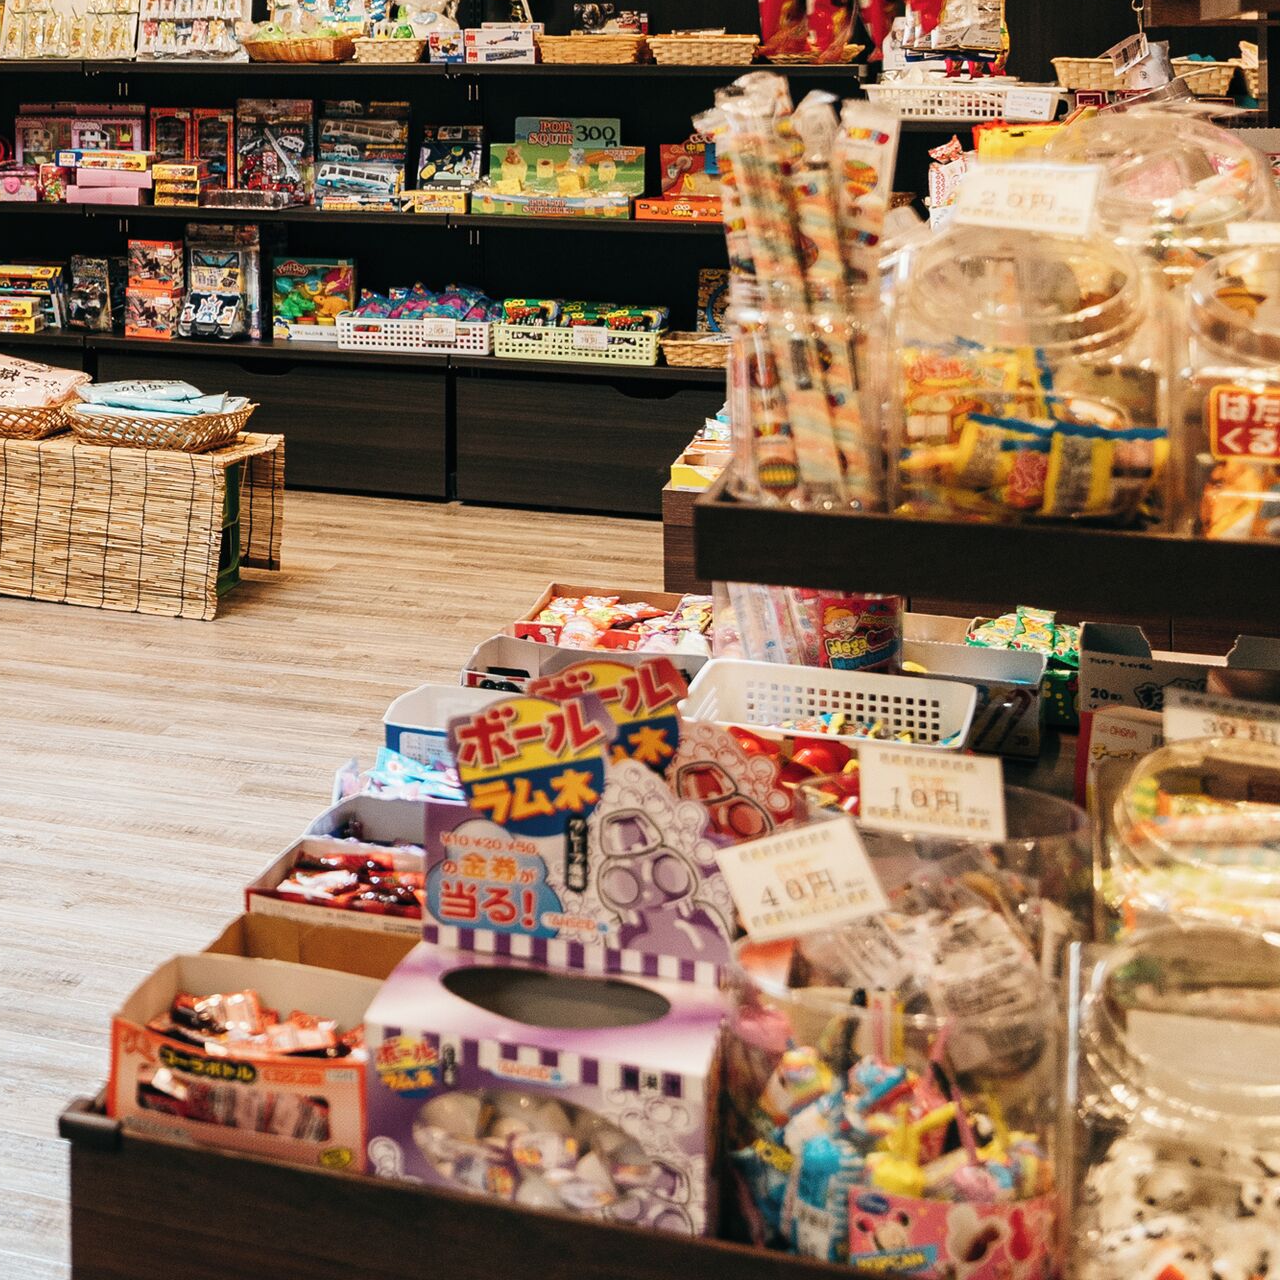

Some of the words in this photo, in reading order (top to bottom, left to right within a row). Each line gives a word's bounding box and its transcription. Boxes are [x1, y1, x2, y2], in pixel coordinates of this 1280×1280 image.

[575, 124, 615, 142] 300
[456, 695, 605, 769] ボール
[442, 851, 535, 887] の金券が
[758, 867, 839, 908] 40円
